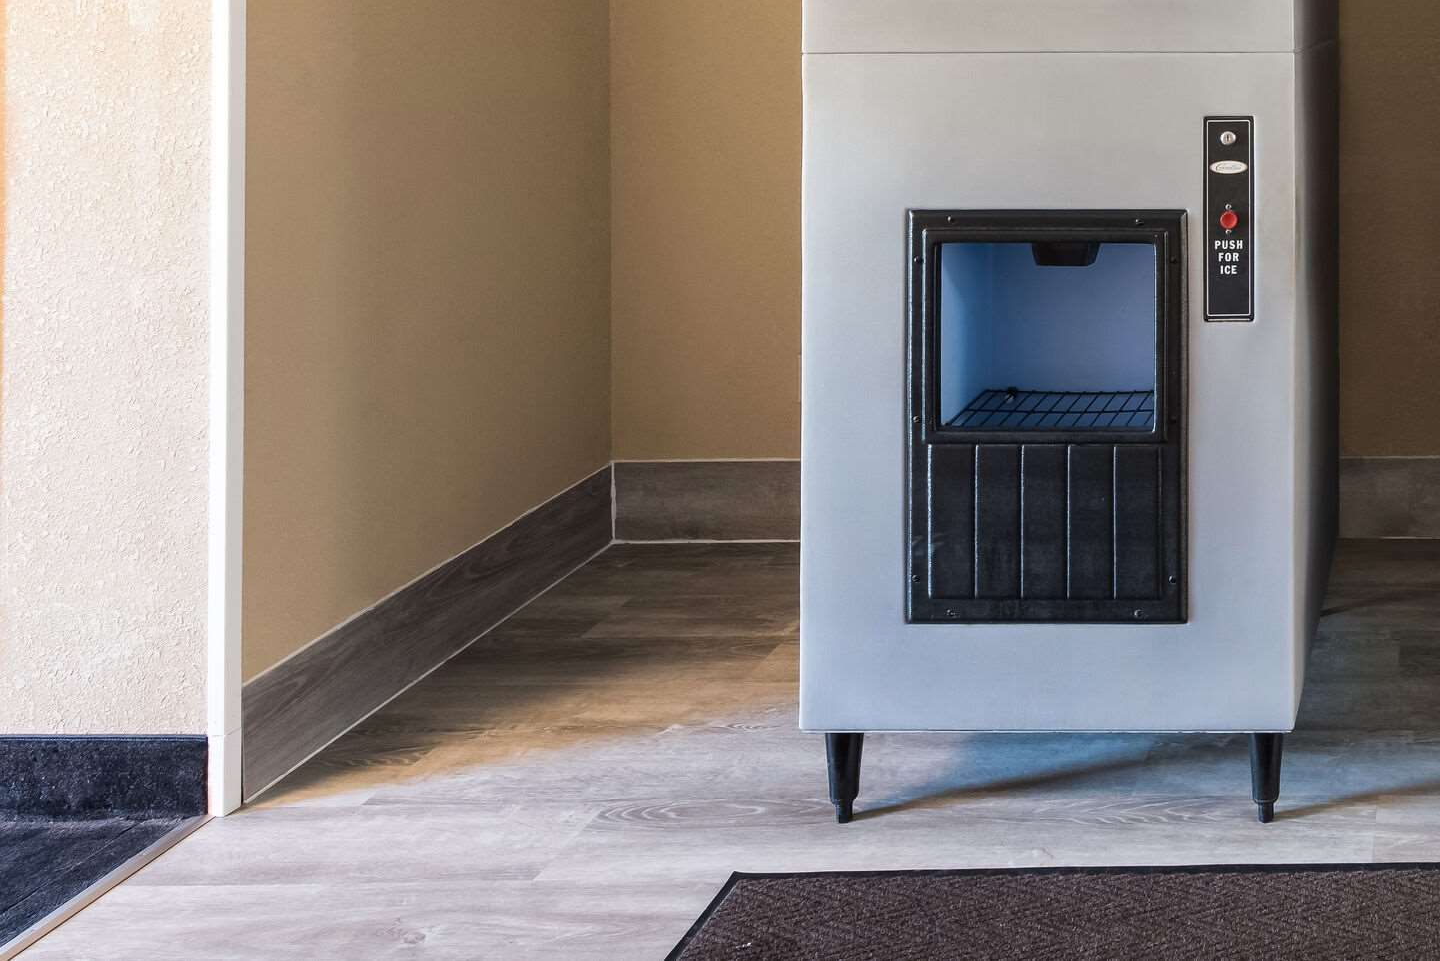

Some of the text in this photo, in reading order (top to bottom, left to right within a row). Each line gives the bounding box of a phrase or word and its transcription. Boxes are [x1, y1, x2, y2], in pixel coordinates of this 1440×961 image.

[1214, 239, 1244, 250] PUSH
[1218, 252, 1240, 262] FOR
[1219, 265, 1238, 275] ICE
